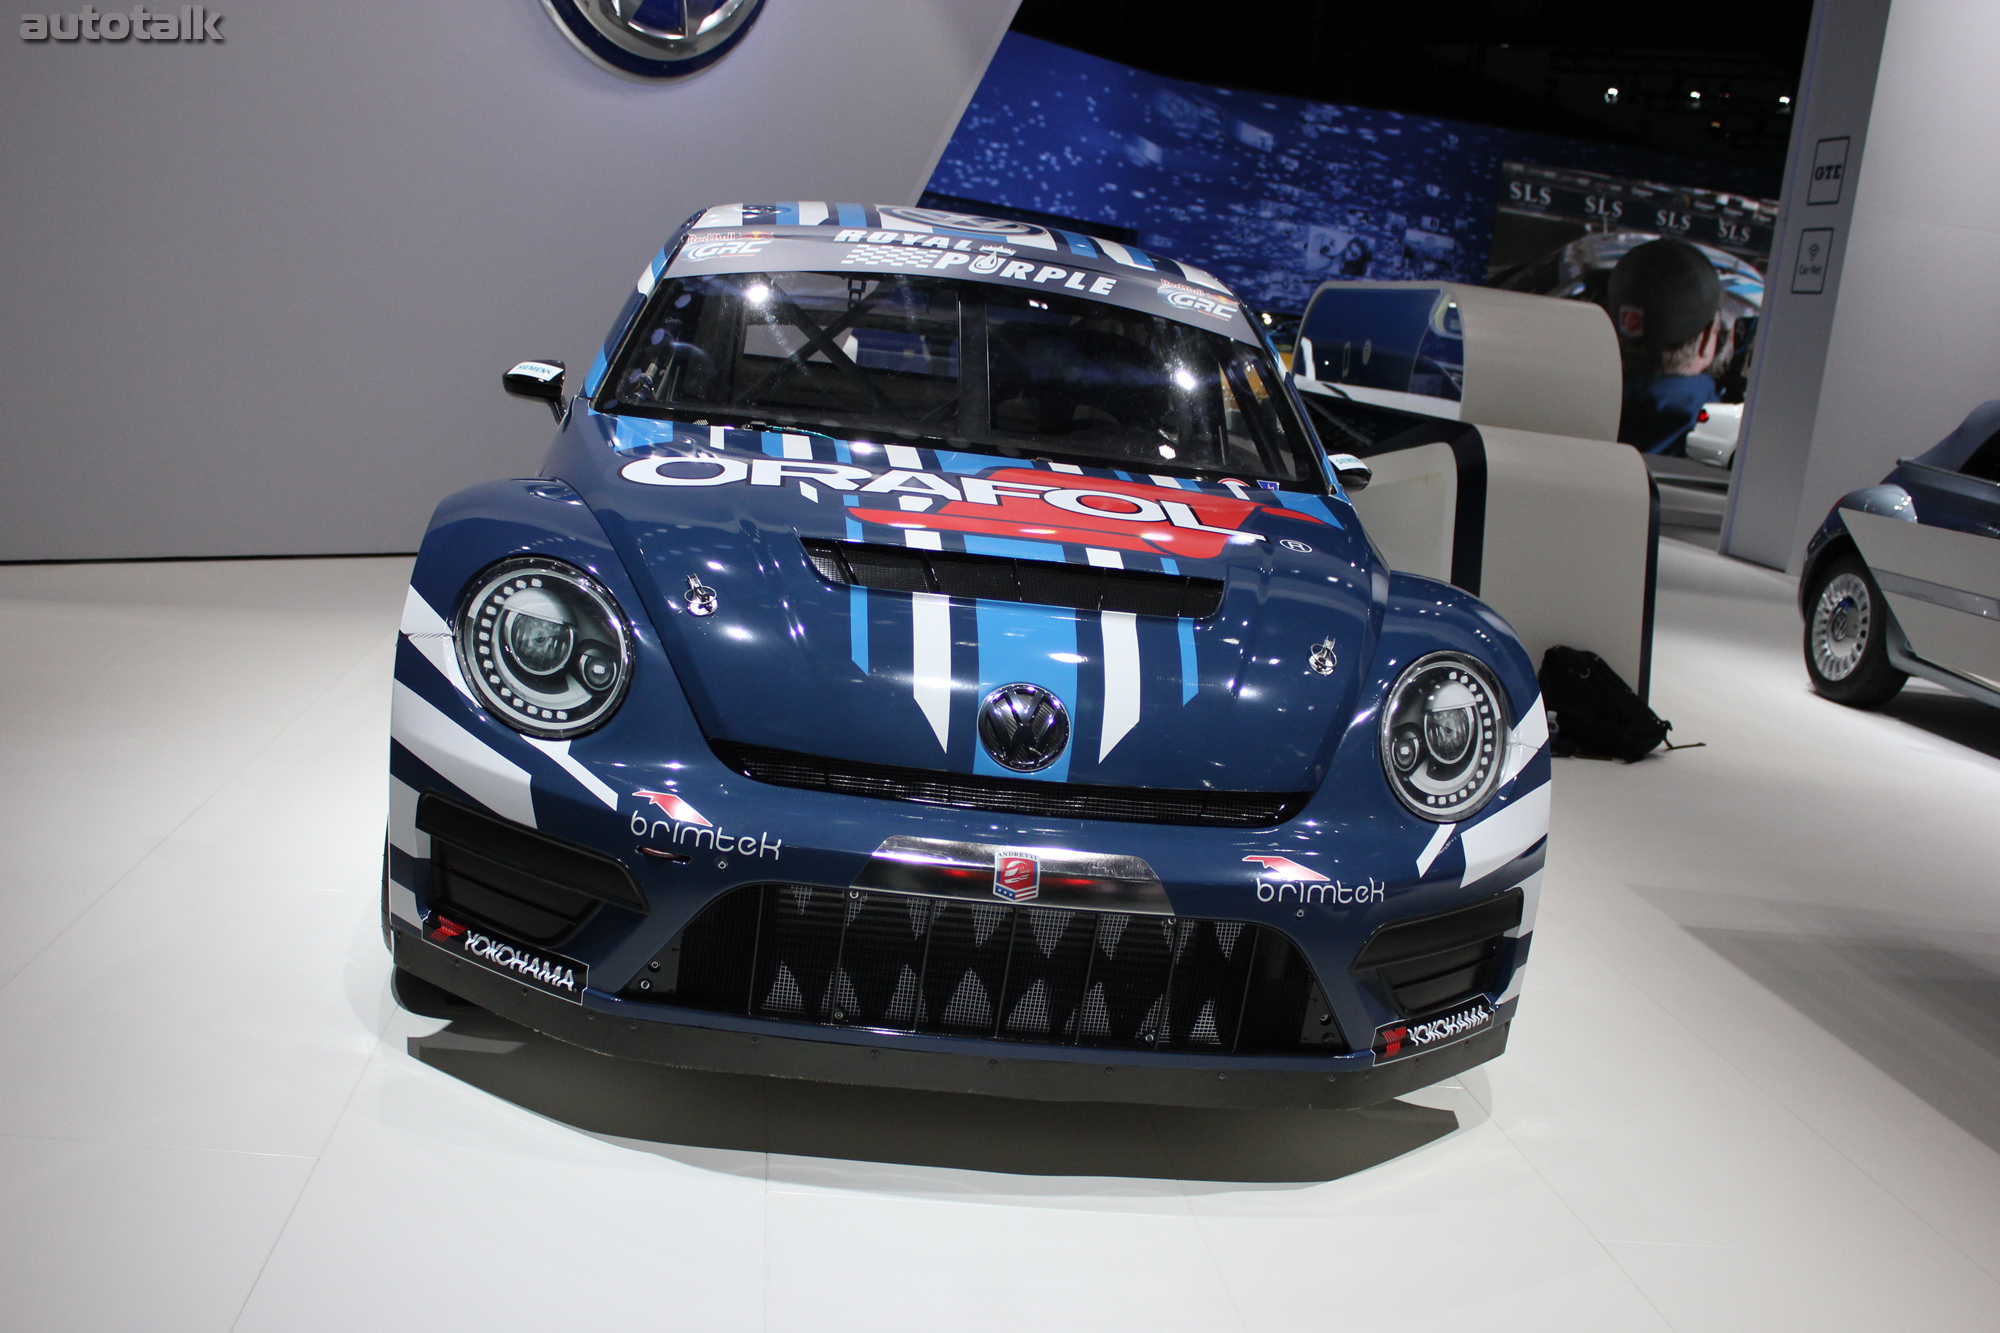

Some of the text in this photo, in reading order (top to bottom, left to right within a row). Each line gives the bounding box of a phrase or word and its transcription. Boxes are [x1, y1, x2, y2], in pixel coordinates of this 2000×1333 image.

[1815, 165, 1842, 181] GTE
[1509, 181, 1751, 243] SLS SLS SLS SLS
[687, 231, 735, 243] Red Bull
[694, 239, 773, 258] GRC
[834, 229, 972, 251] ROYAL
[933, 251, 1117, 296] PURPLE
[1172, 294, 1238, 319] GRC
[620, 456, 1268, 542] ORAFOL
[630, 810, 782, 861] brimtek
[1256, 877, 1385, 904] brimtek
[464, 930, 575, 992] YOKOHAMA
[1407, 1005, 1489, 1046] YOKOHAMA
